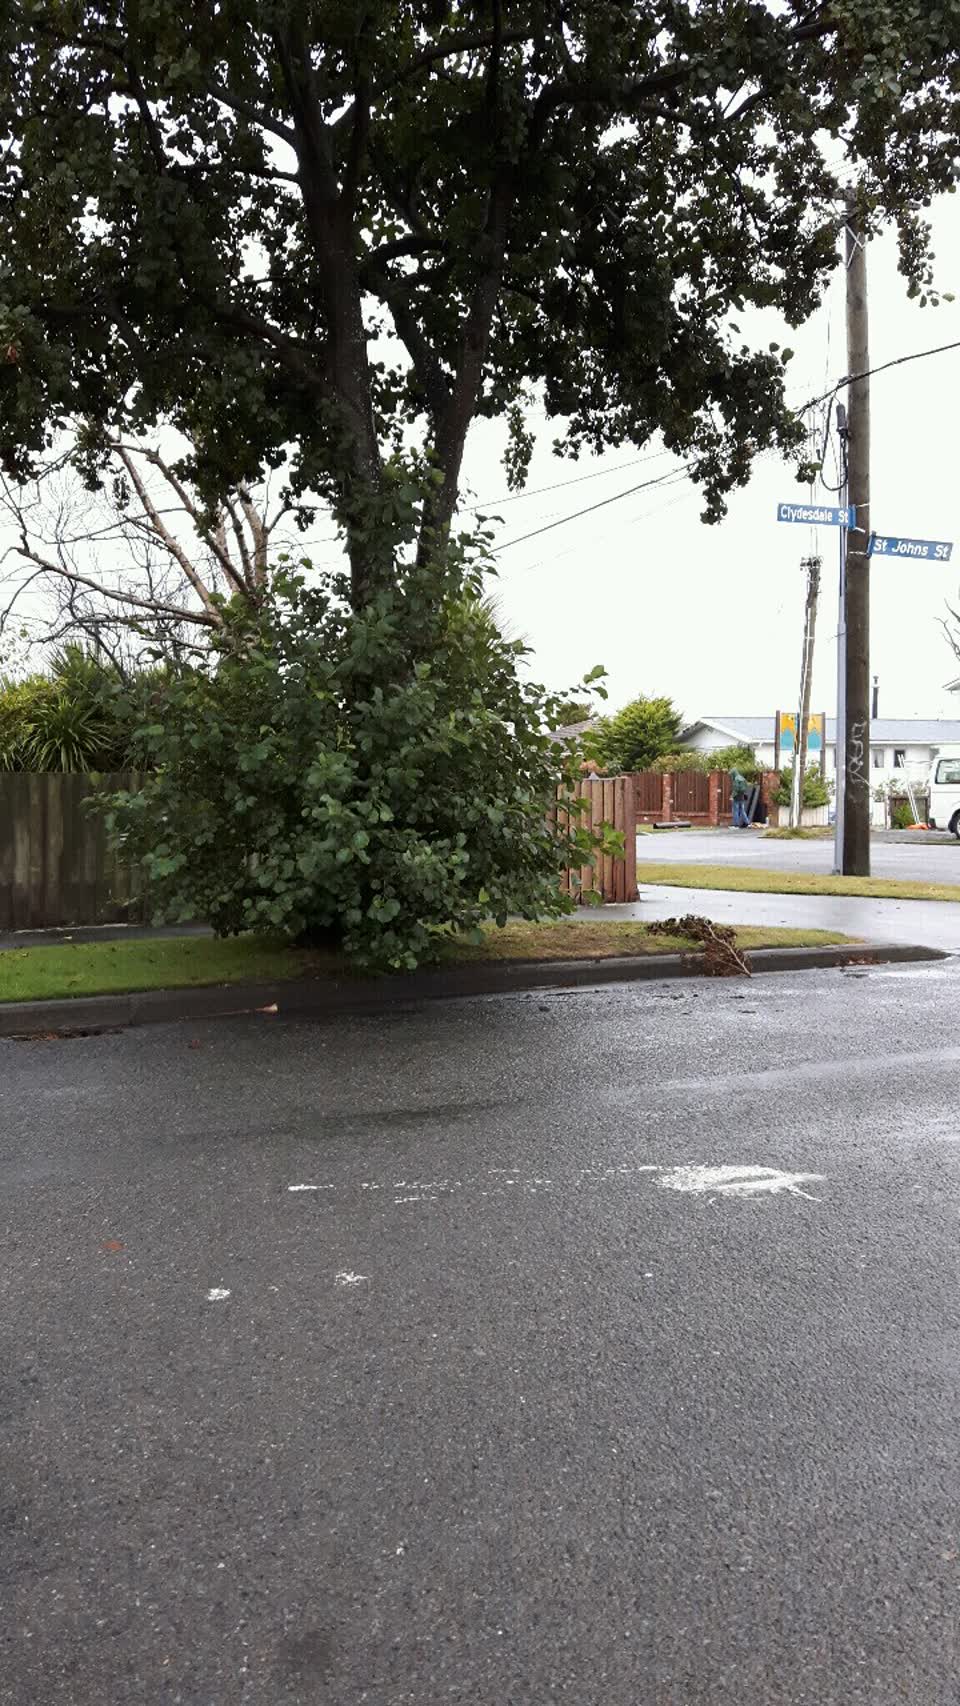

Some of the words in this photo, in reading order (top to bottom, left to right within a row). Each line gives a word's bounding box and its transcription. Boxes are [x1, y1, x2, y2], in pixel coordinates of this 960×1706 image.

[780, 505, 833, 522] Clydesdale
[838, 510, 849, 523] St
[873, 539, 888, 552] St
[891, 541, 929, 556] Johns
[934, 545, 950, 558] St
